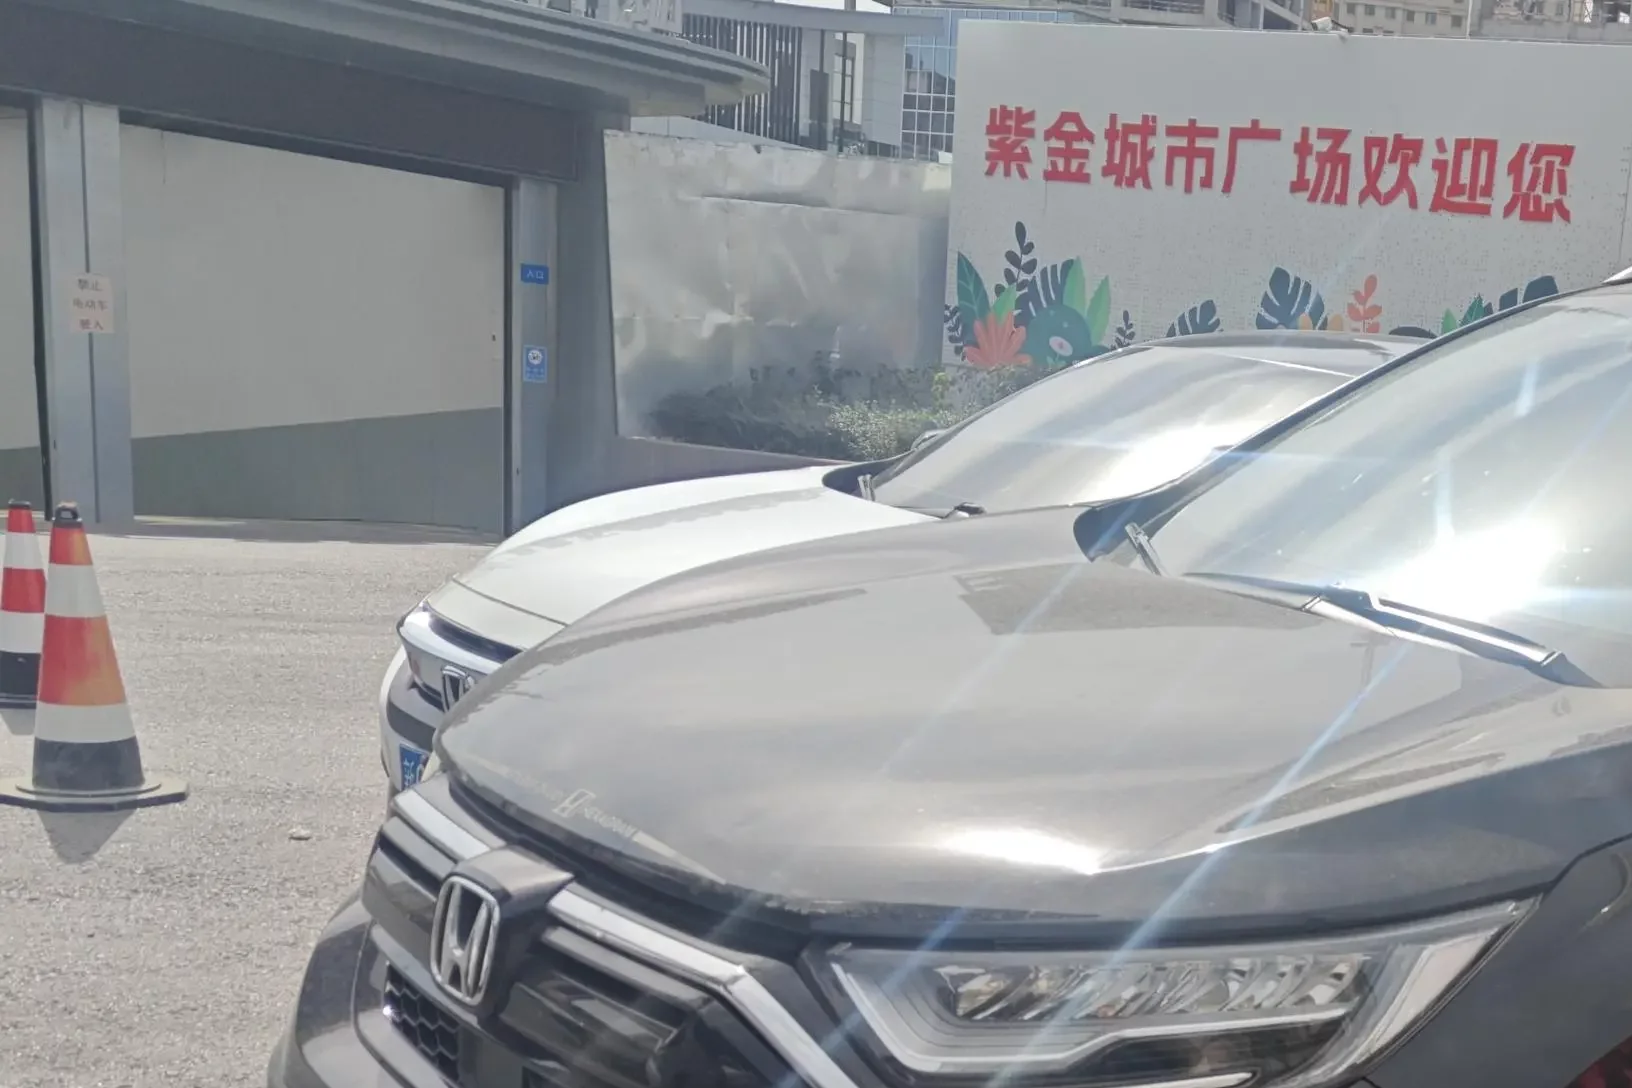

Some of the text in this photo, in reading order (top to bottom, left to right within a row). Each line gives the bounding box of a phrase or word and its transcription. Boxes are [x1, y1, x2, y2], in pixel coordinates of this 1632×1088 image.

[984, 105, 1576, 224] 紫金城市广场欢迎您
[526, 269, 545, 280] 入口
